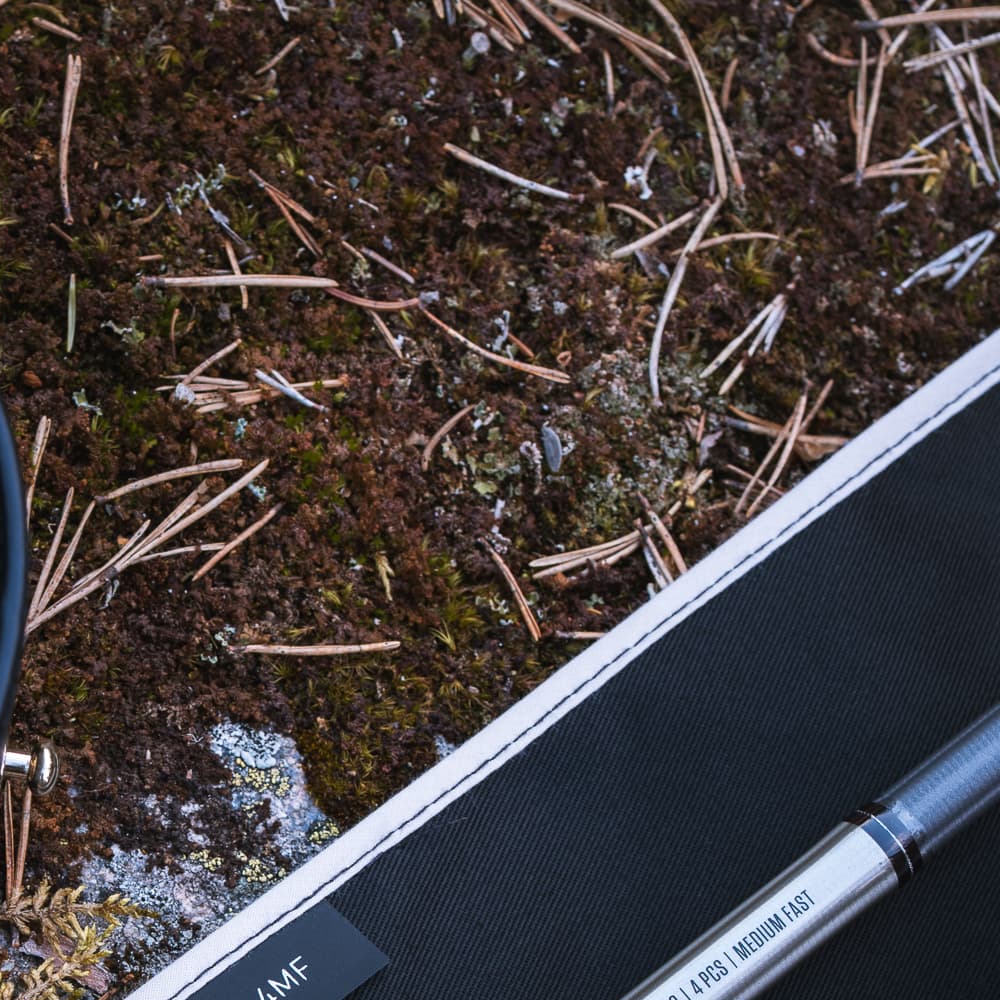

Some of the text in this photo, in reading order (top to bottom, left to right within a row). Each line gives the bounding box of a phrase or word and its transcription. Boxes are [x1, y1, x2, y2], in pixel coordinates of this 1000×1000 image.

[690, 979, 704, 996] 4
[698, 959, 728, 988] PCS
[732, 913, 787, 961] MEDIUM
[781, 889, 815, 922] FAST
